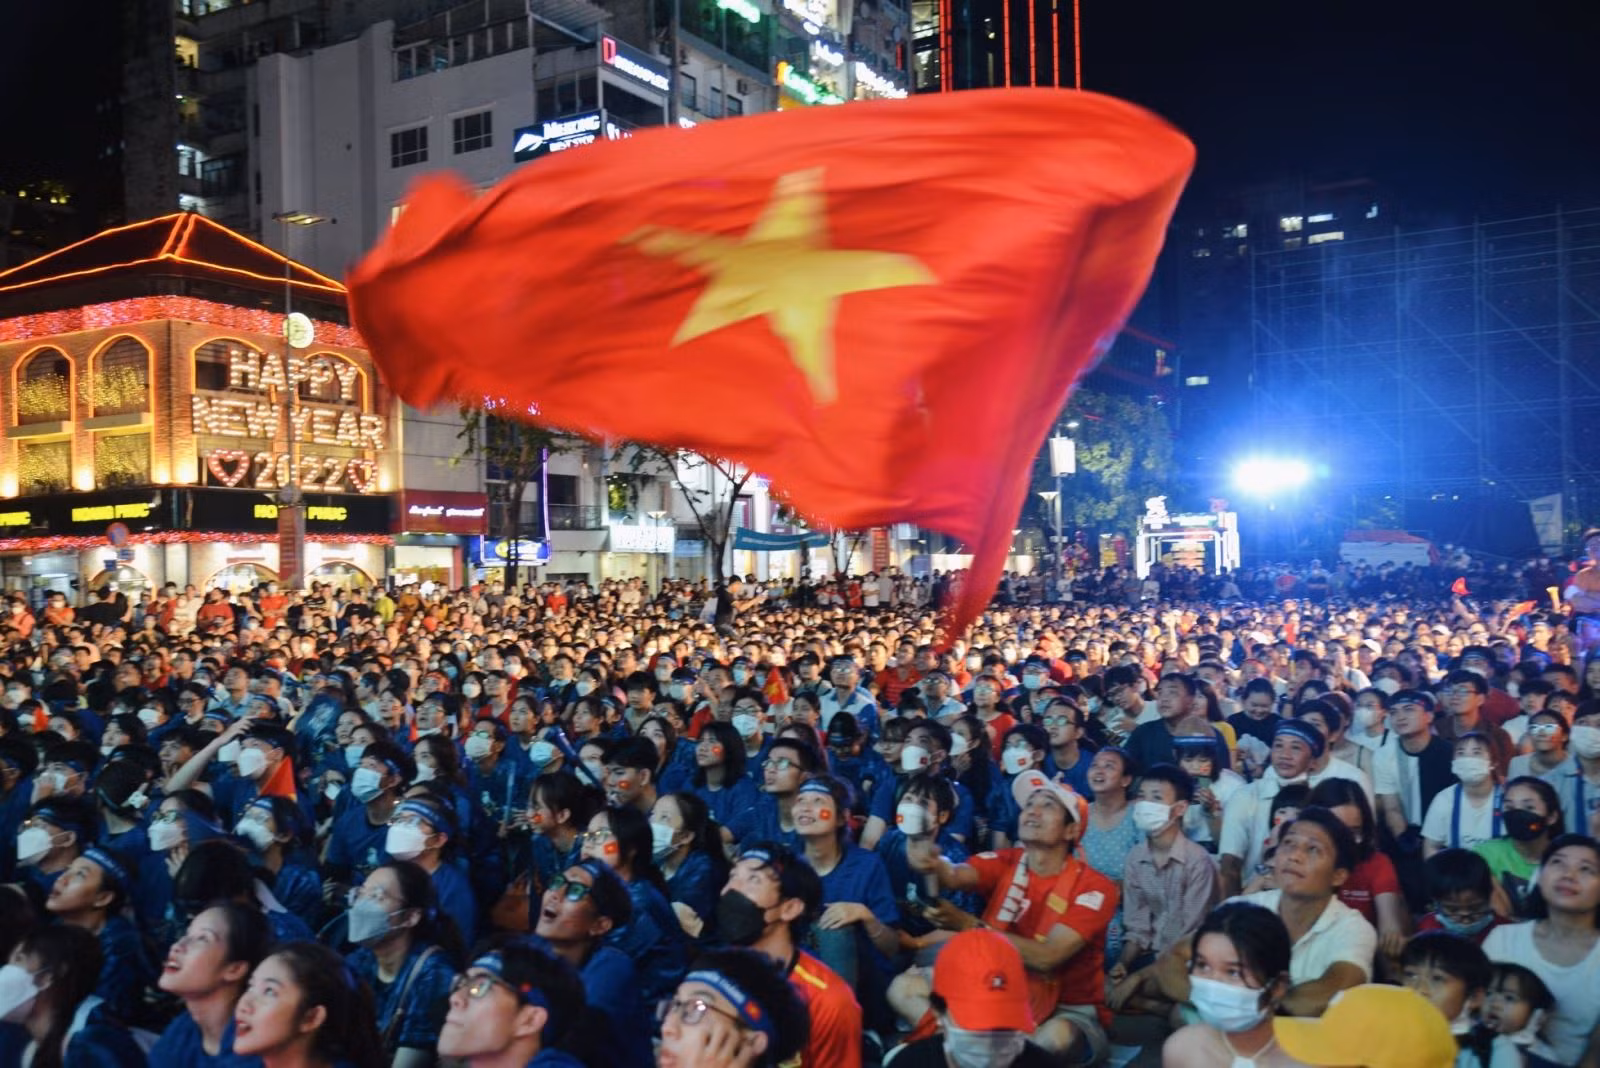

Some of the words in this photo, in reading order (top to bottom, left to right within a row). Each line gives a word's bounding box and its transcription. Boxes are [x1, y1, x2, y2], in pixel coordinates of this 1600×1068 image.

[229, 349, 359, 400] HAPPY
[192, 395, 280, 438] NEW
[290, 407, 385, 450] YEAR
[253, 451, 350, 492] 2022
